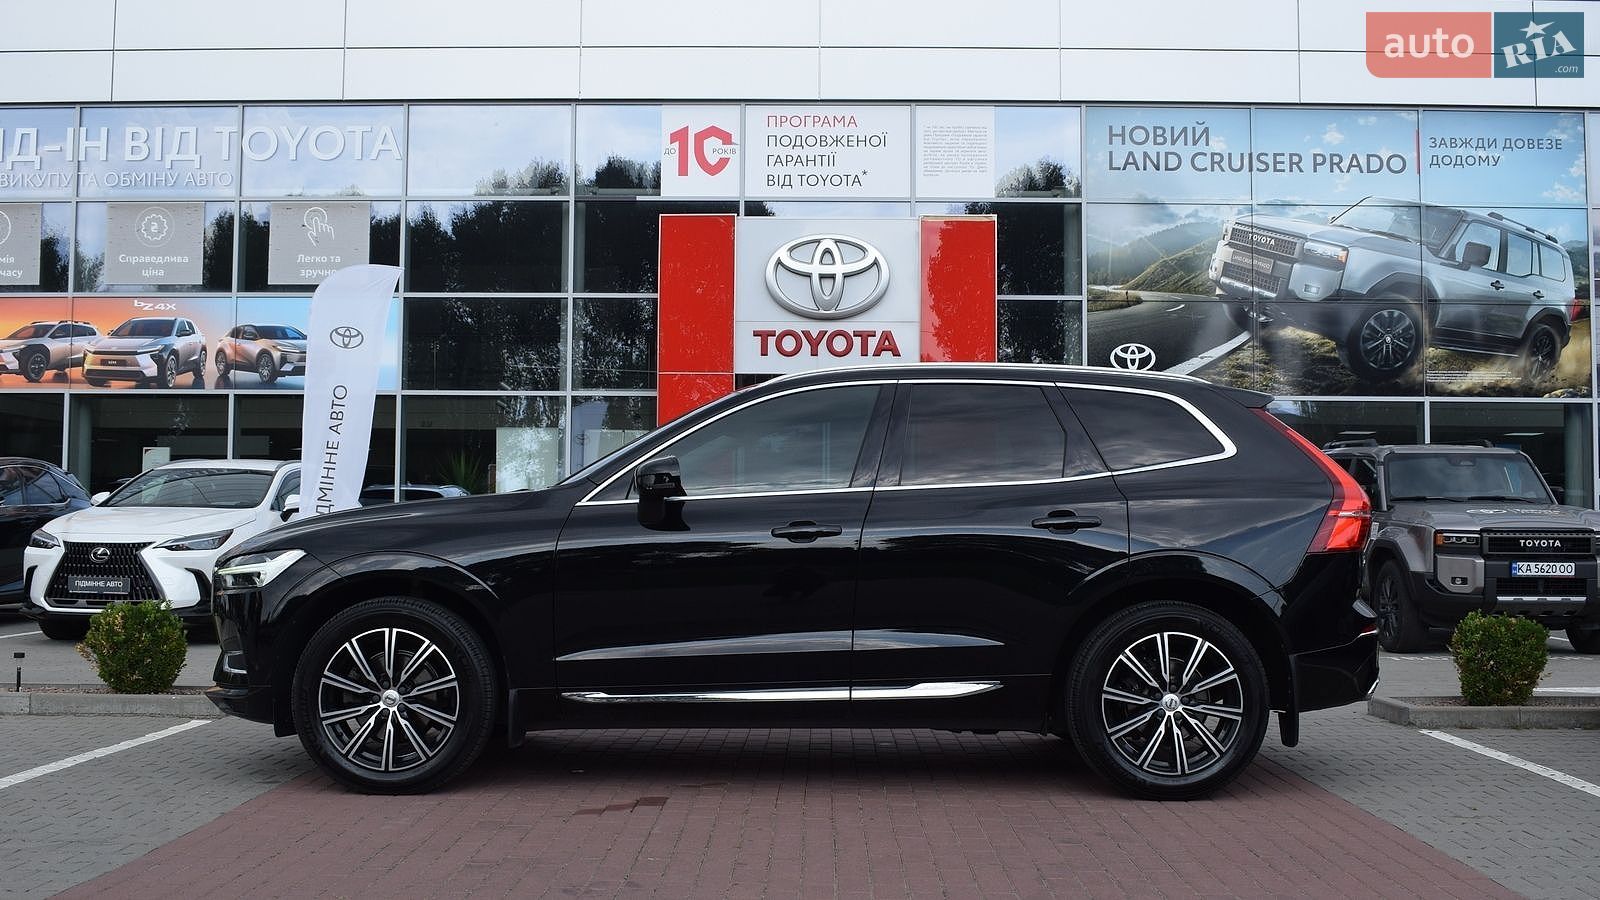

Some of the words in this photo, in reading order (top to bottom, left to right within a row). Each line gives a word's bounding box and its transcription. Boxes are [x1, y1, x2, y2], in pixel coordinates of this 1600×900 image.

[766, 115, 858, 128] ПРОГРАМА
[766, 131, 888, 150] ПОДОВЖЕНОЇ
[1108, 121, 1210, 147] НОВИЙ
[124, 126, 201, 169] ВІД
[213, 125, 403, 162] TOYOTA
[712, 147, 737, 155] РОКІВ
[1429, 136, 1497, 151] ЗАВЖДИ
[1502, 137, 1563, 151] ДОВЕЗЕ
[663, 147, 677, 156] ДО
[766, 151, 837, 167] ГАРАНТІЇ
[1108, 151, 1183, 172] LAND
[1190, 152, 1304, 173] CRUISER
[1312, 153, 1407, 175] PRADO
[1429, 154, 1501, 169] ДОДОМУ
[77, 172, 99, 187] ТА
[104, 171, 179, 187] ОБМІНУ
[184, 171, 233, 187] АВТО
[766, 174, 793, 189] ВІД
[1248, 234, 1275, 246] TOYOTA
[118, 254, 189, 264] Справедлива
[297, 254, 327, 264] Легко
[330, 255, 341, 263] та
[142, 267, 165, 277] ціна
[753, 329, 901, 357] TOYOTA
[328, 384, 348, 435] АВТО
[1519, 539, 1562, 548] TOYOTA
[1517, 564, 1532, 573] KA
[1534, 564, 1557, 573] 5620
